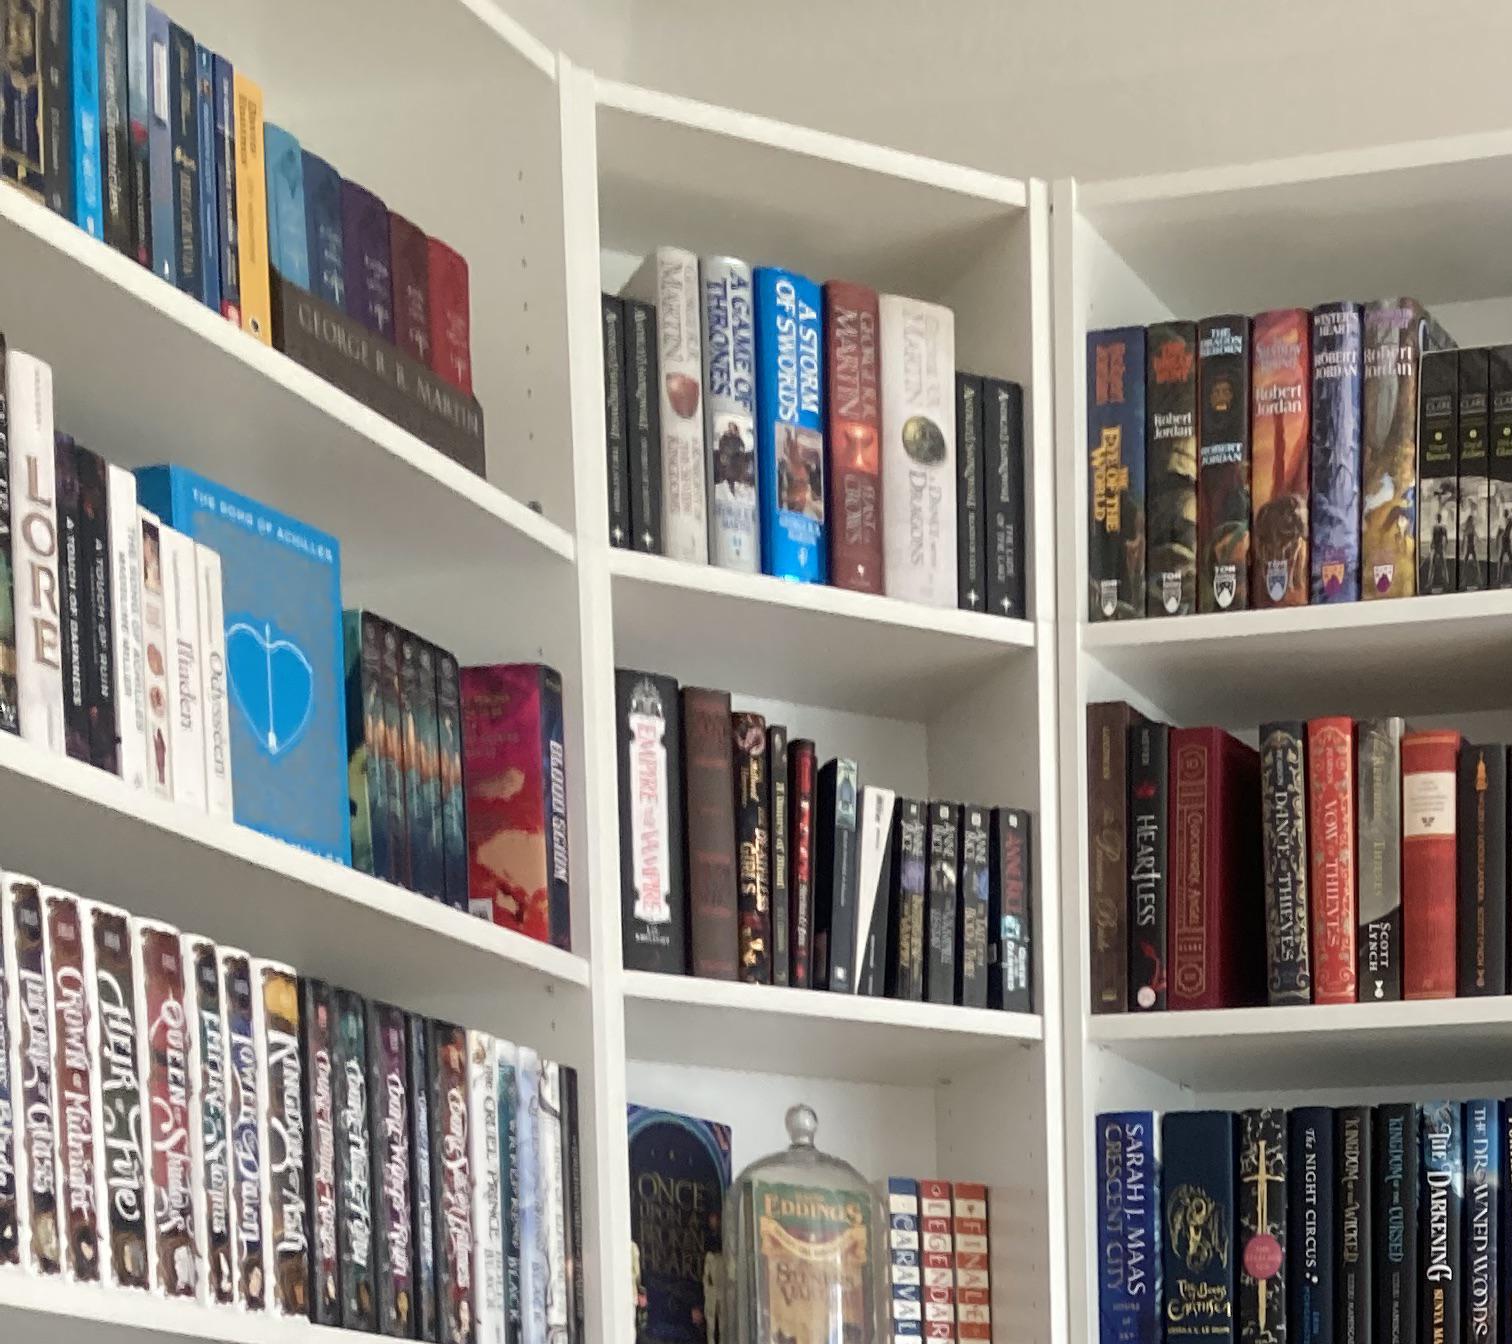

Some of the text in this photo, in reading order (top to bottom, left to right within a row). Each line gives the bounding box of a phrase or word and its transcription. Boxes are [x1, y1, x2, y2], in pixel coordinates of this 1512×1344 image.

[776, 280, 797, 421] OF SWORDS
[799, 324, 818, 413] STORM
[22, 455, 61, 671] LORE
[1132, 814, 1161, 925] HEARTLESS
[1369, 923, 1380, 972] LYNCH
[1380, 922, 1391, 968] SCOTT
[1124, 1123, 1144, 1200] SARAH
[1304, 1153, 1317, 1204] NIGHT
[1127, 1227, 1146, 1295] MAAS
[1305, 1210, 1317, 1268] CIRCUS
[1427, 1171, 1452, 1281] DARKENING
[891, 1213, 911, 1337] CARAVAL
